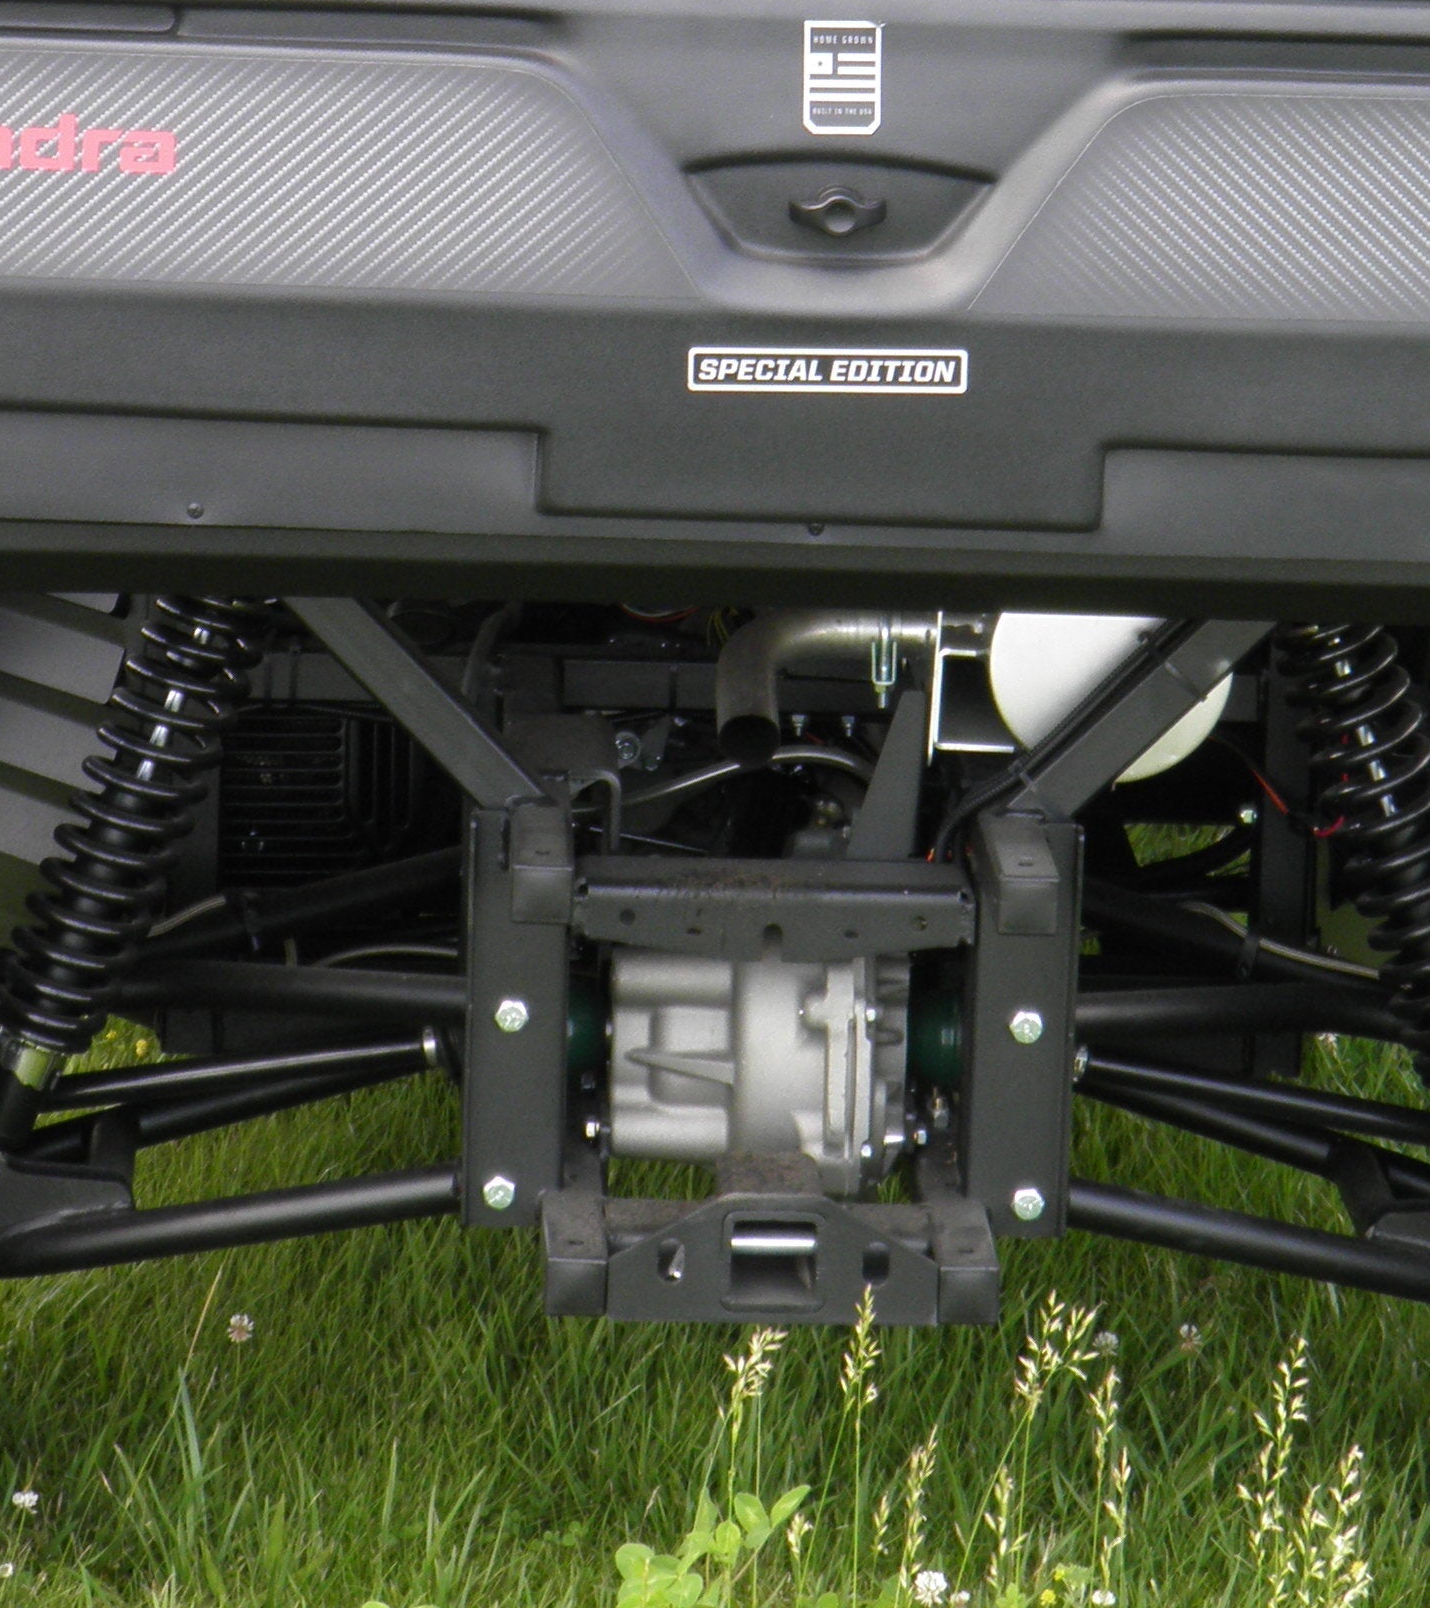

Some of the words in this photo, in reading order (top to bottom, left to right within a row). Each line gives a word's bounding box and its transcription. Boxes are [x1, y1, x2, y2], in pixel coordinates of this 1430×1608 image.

[813, 35, 837, 44] HOME
[842, 35, 874, 45] GROWN
[845, 107, 857, 115] THE
[698, 358, 823, 382] SPECIAL
[830, 359, 956, 383] EDITION
